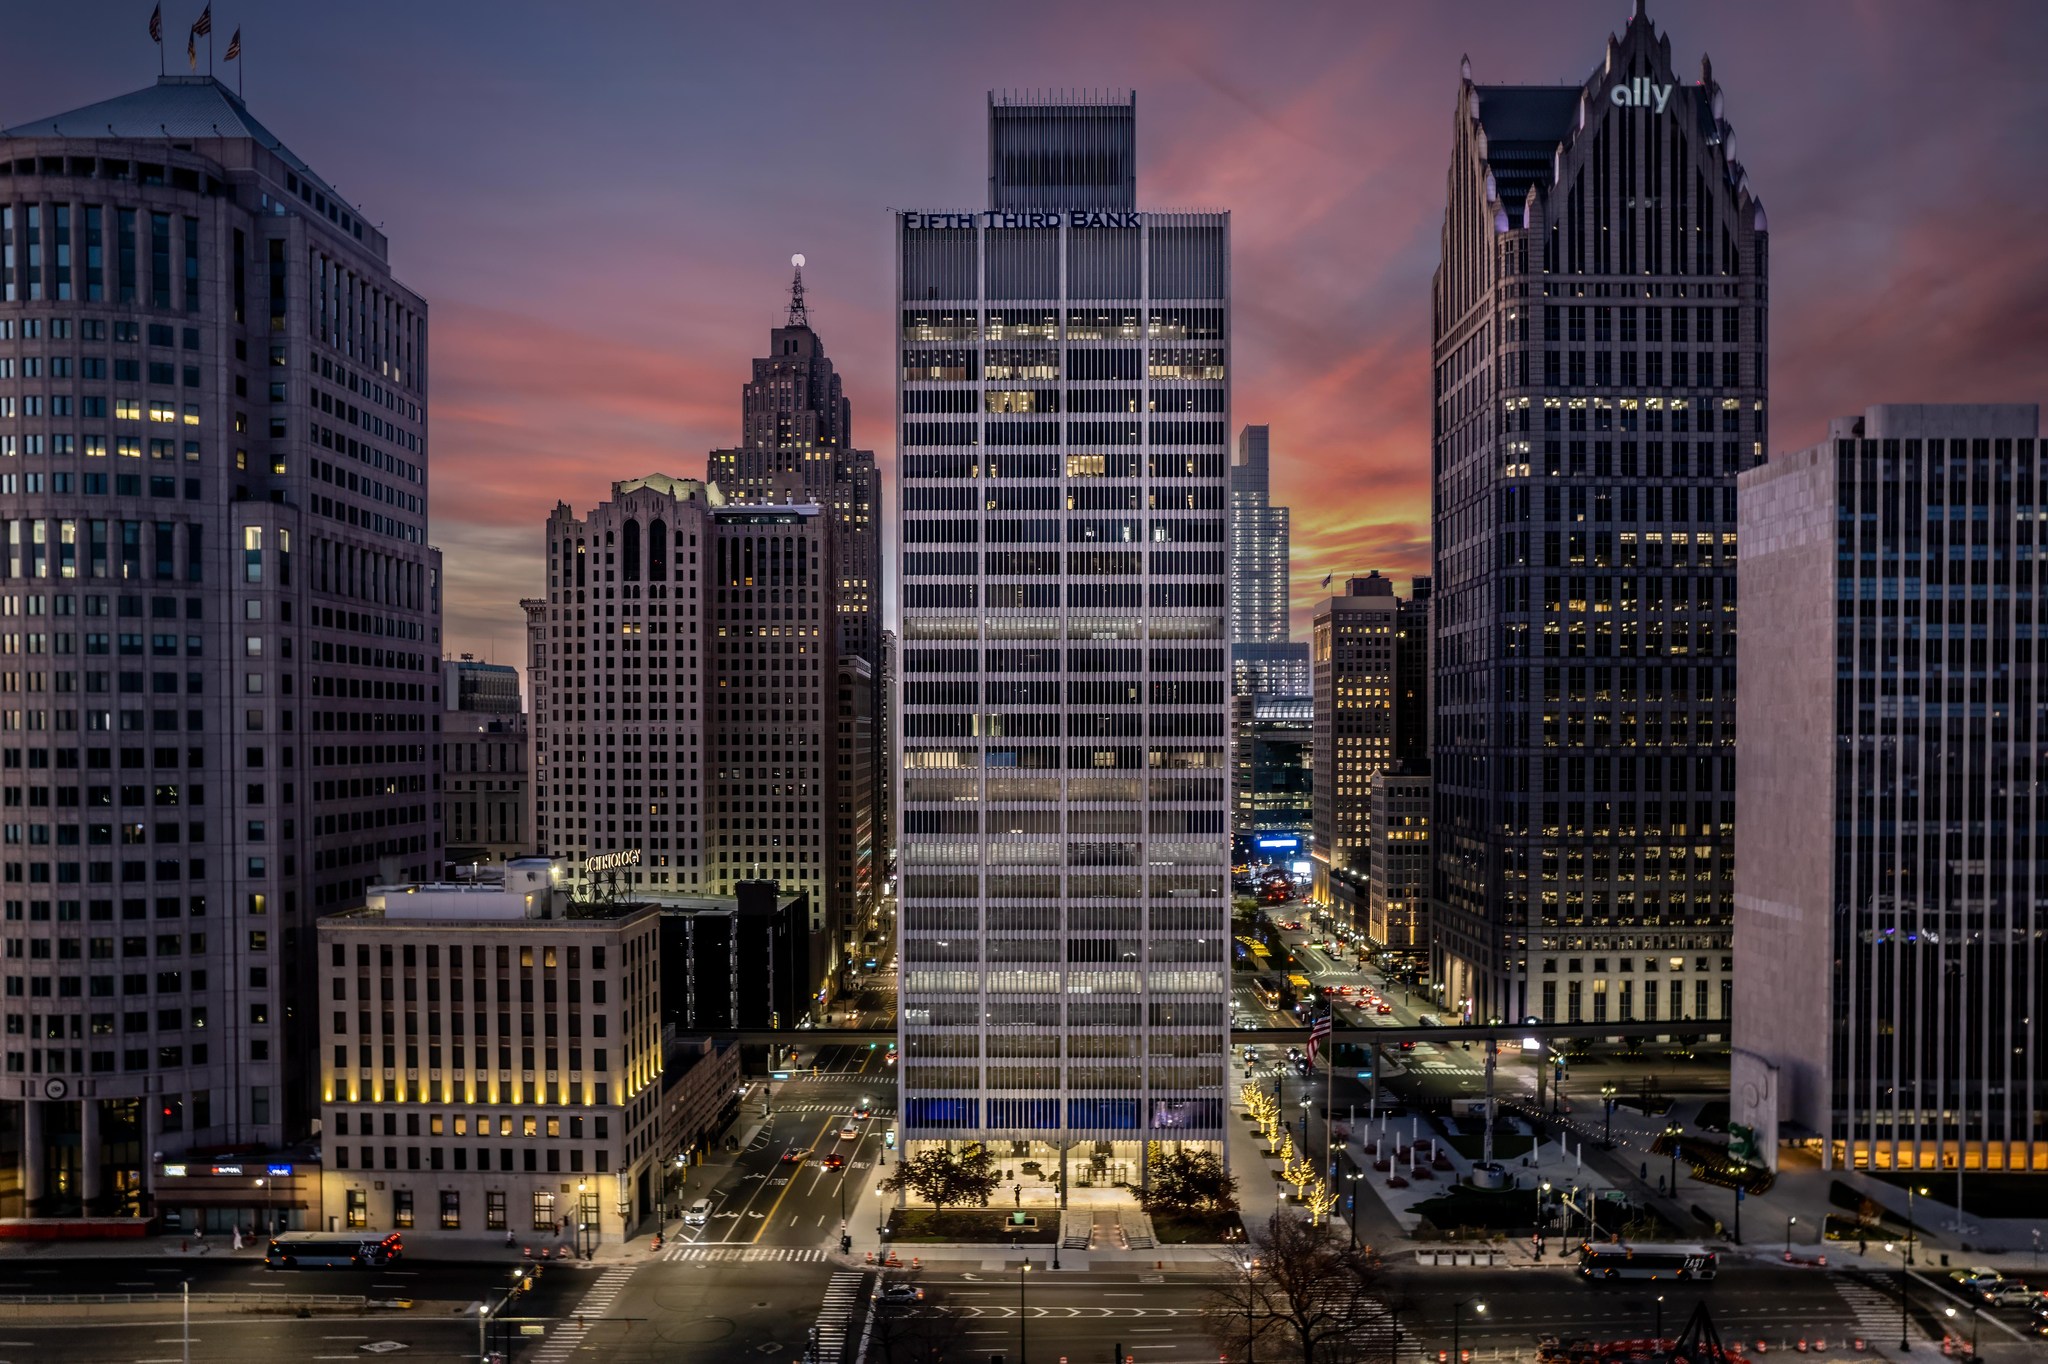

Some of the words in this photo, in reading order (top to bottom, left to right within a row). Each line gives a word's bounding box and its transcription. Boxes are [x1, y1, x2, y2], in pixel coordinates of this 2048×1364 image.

[1611, 77, 1673, 114] ally
[903, 212, 974, 229] FIFTH
[983, 211, 1062, 229] THIRD
[1069, 210, 1141, 229] BANK
[585, 849, 641, 873] SCIENTOLOGY
[852, 1161, 871, 1169] ONLY
[359, 1245, 380, 1255] FAST
[1683, 1258, 1705, 1268] FAST
